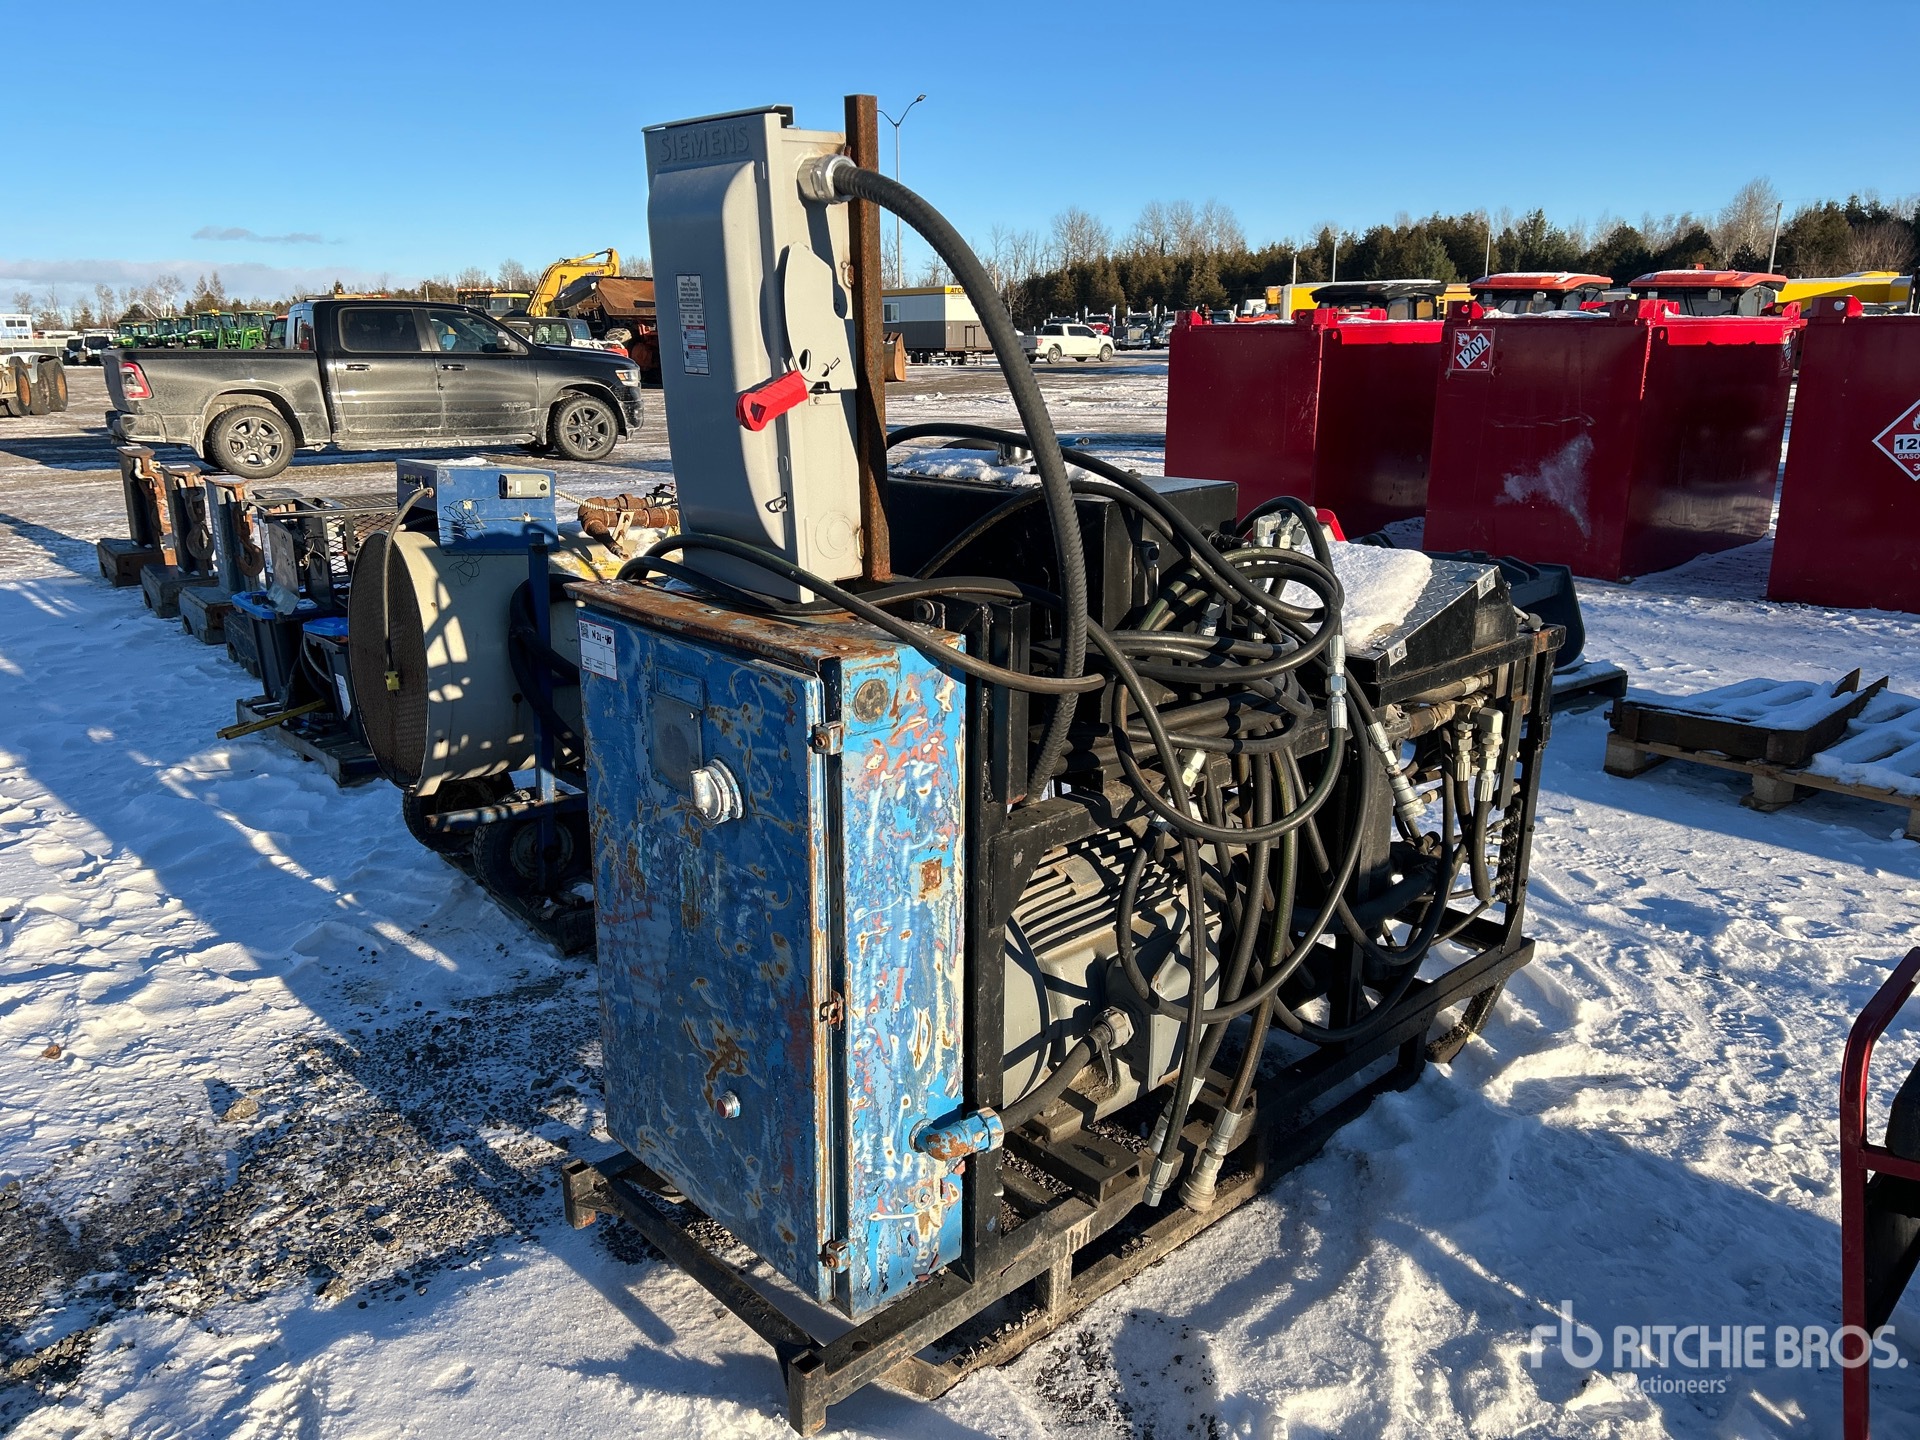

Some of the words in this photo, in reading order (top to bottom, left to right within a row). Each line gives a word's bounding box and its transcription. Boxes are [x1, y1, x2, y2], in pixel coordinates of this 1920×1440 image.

[660, 123, 749, 162] SIEMENS
[1458, 336, 1489, 366] 1202
[1480, 360, 1488, 369] 3
[1896, 439, 1920, 449] 12
